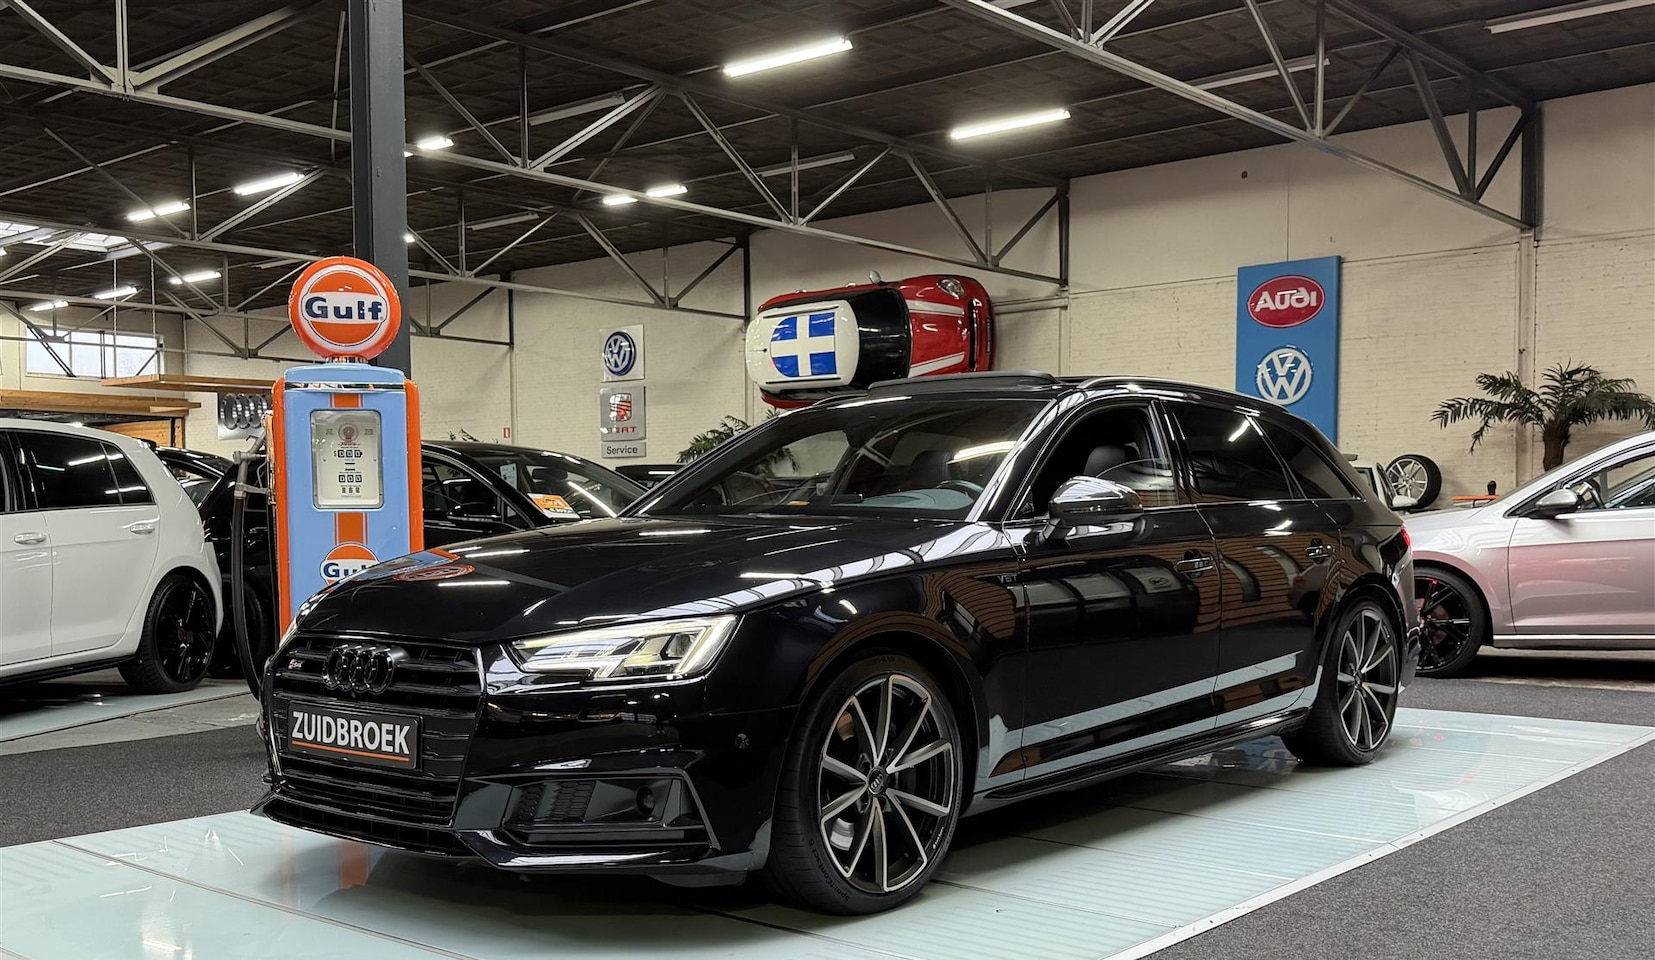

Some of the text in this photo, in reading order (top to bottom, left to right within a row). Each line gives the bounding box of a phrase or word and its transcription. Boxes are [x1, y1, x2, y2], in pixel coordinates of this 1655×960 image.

[305, 296, 382, 320] Gulf
[606, 446, 638, 455] Service
[323, 563, 368, 577] Gu
[292, 711, 410, 755] ZUIDBROEK
